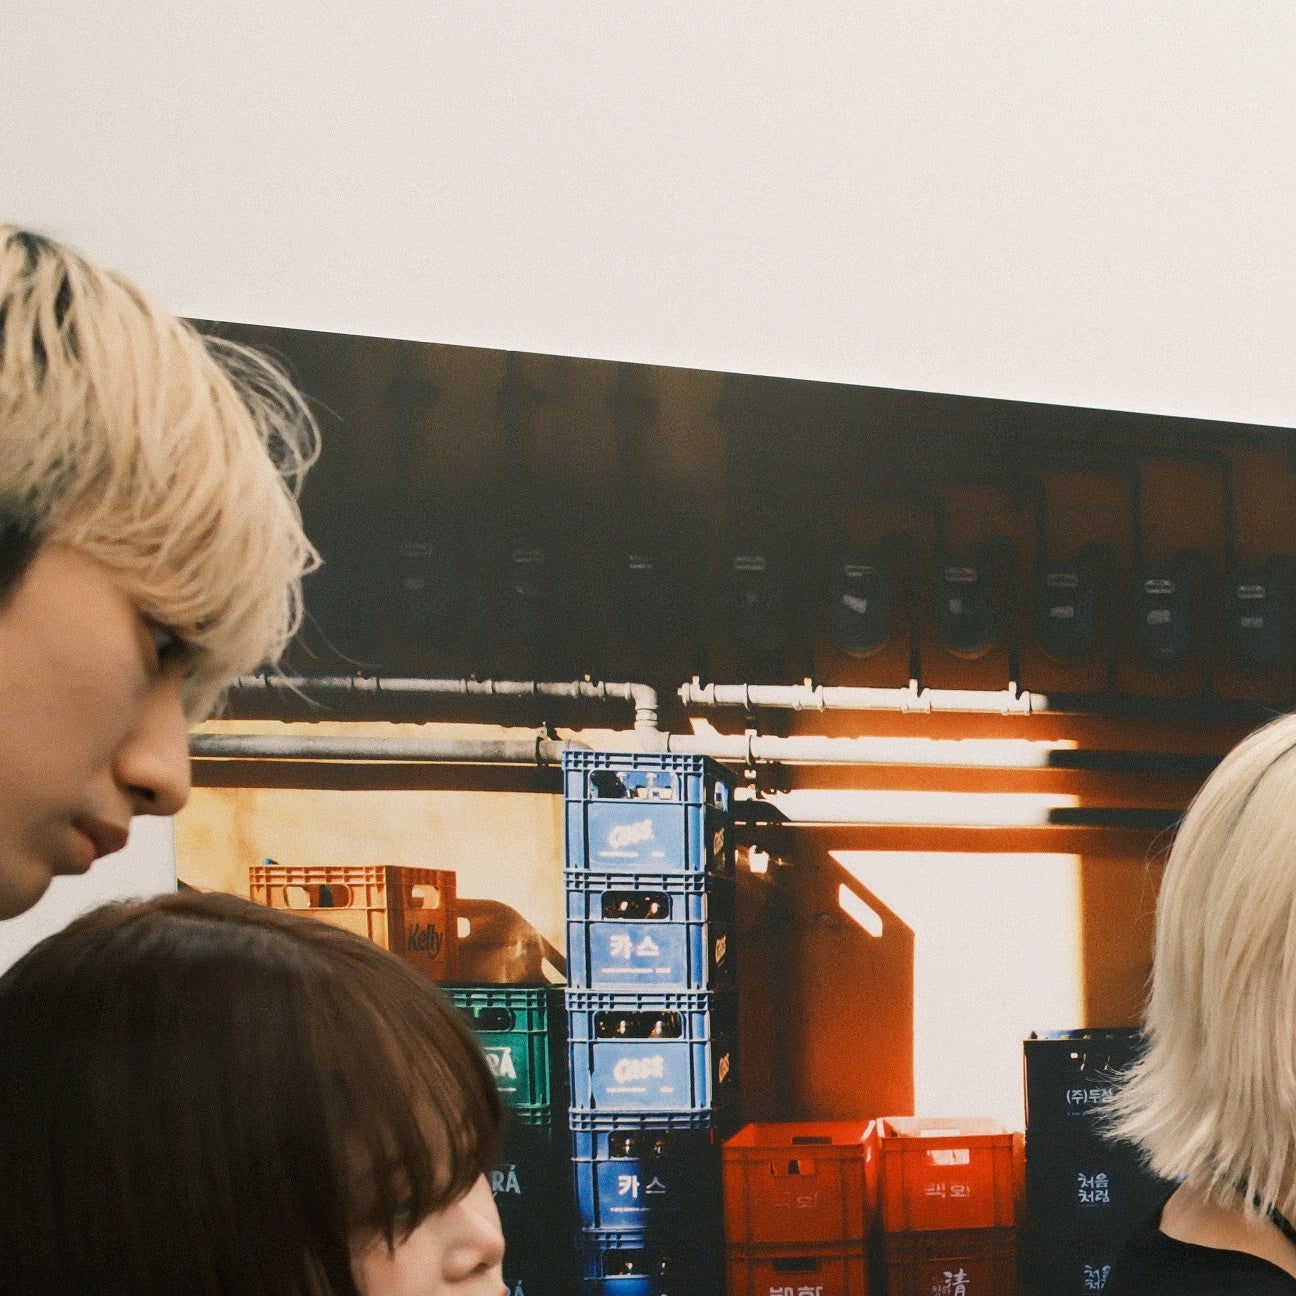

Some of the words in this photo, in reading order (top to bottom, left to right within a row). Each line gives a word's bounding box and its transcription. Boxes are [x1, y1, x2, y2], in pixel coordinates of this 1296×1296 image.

[408, 924, 443, 959] Kelly
[609, 933, 661, 960] 카스
[617, 1174, 667, 1199] 카스
[1077, 1172, 1109, 1189] 처음
[1078, 1189, 1110, 1203] 처럼
